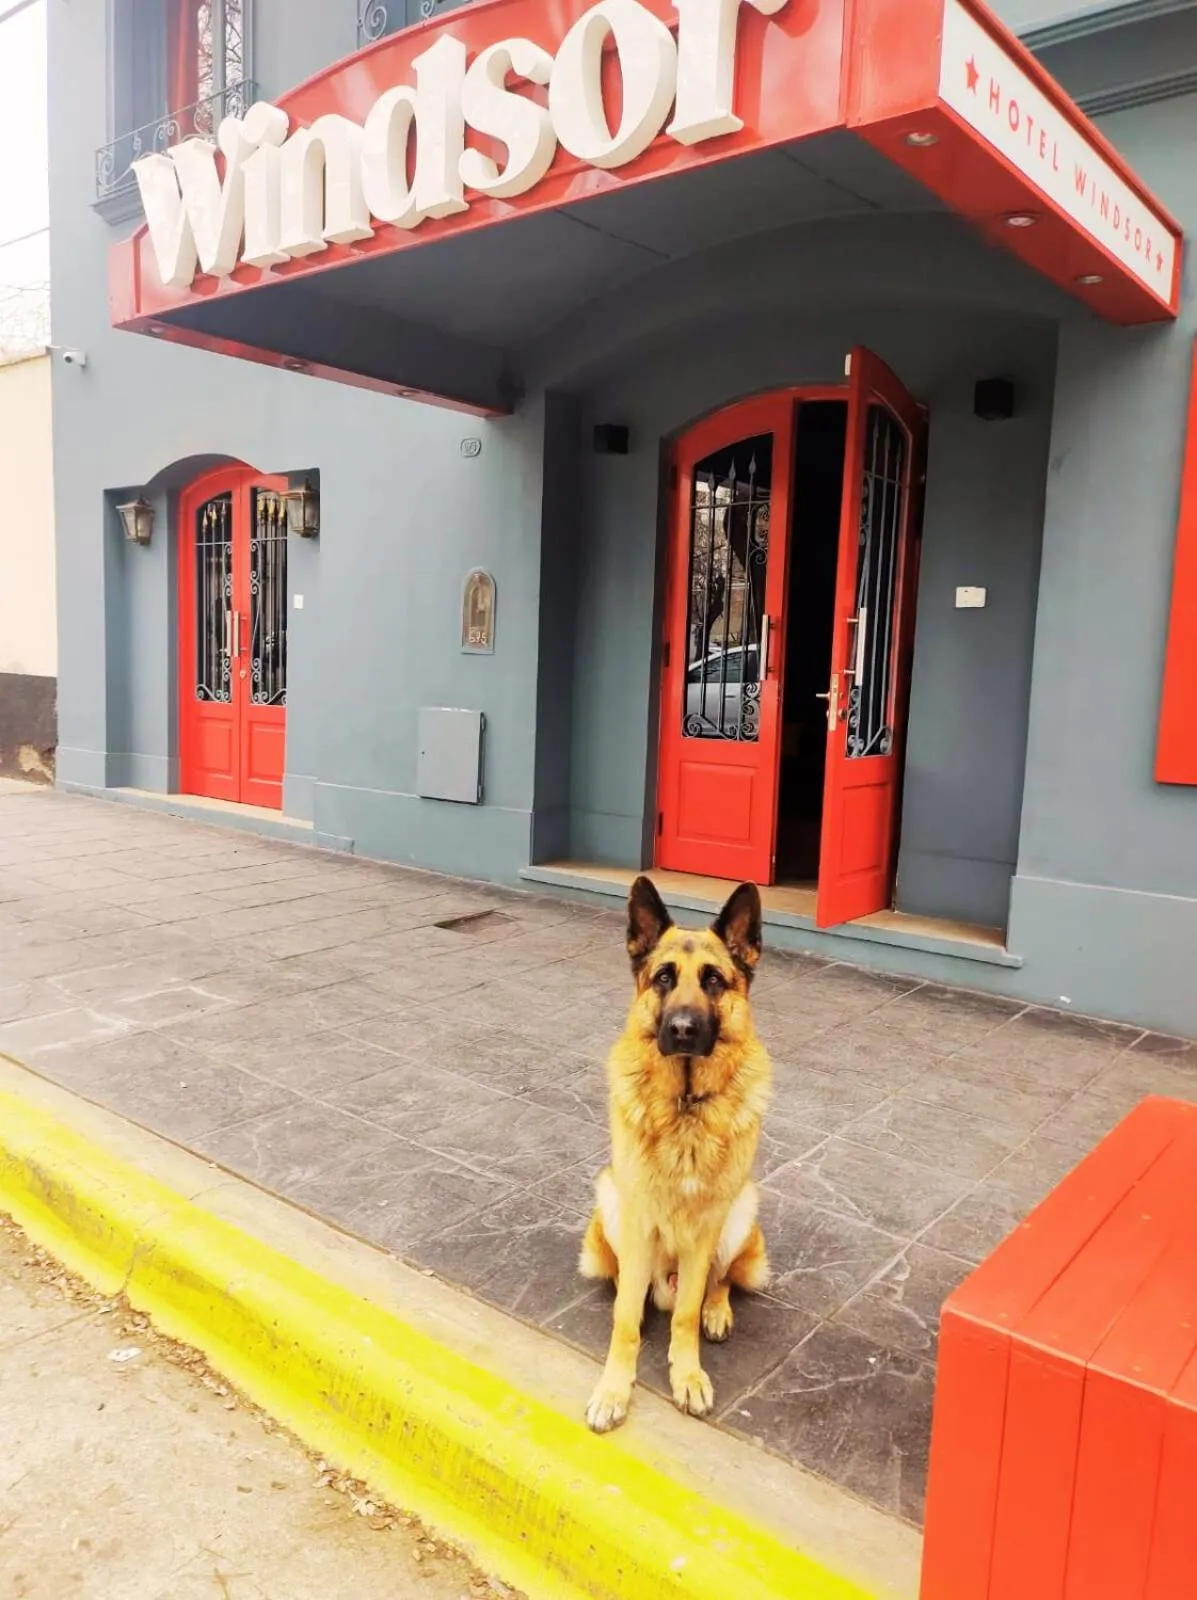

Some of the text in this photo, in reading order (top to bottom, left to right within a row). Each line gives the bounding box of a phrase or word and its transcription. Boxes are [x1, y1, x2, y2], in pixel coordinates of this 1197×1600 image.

[131, 0, 788, 287] windsor
[988, 77, 1152, 261] HOTEL WINDSOR
